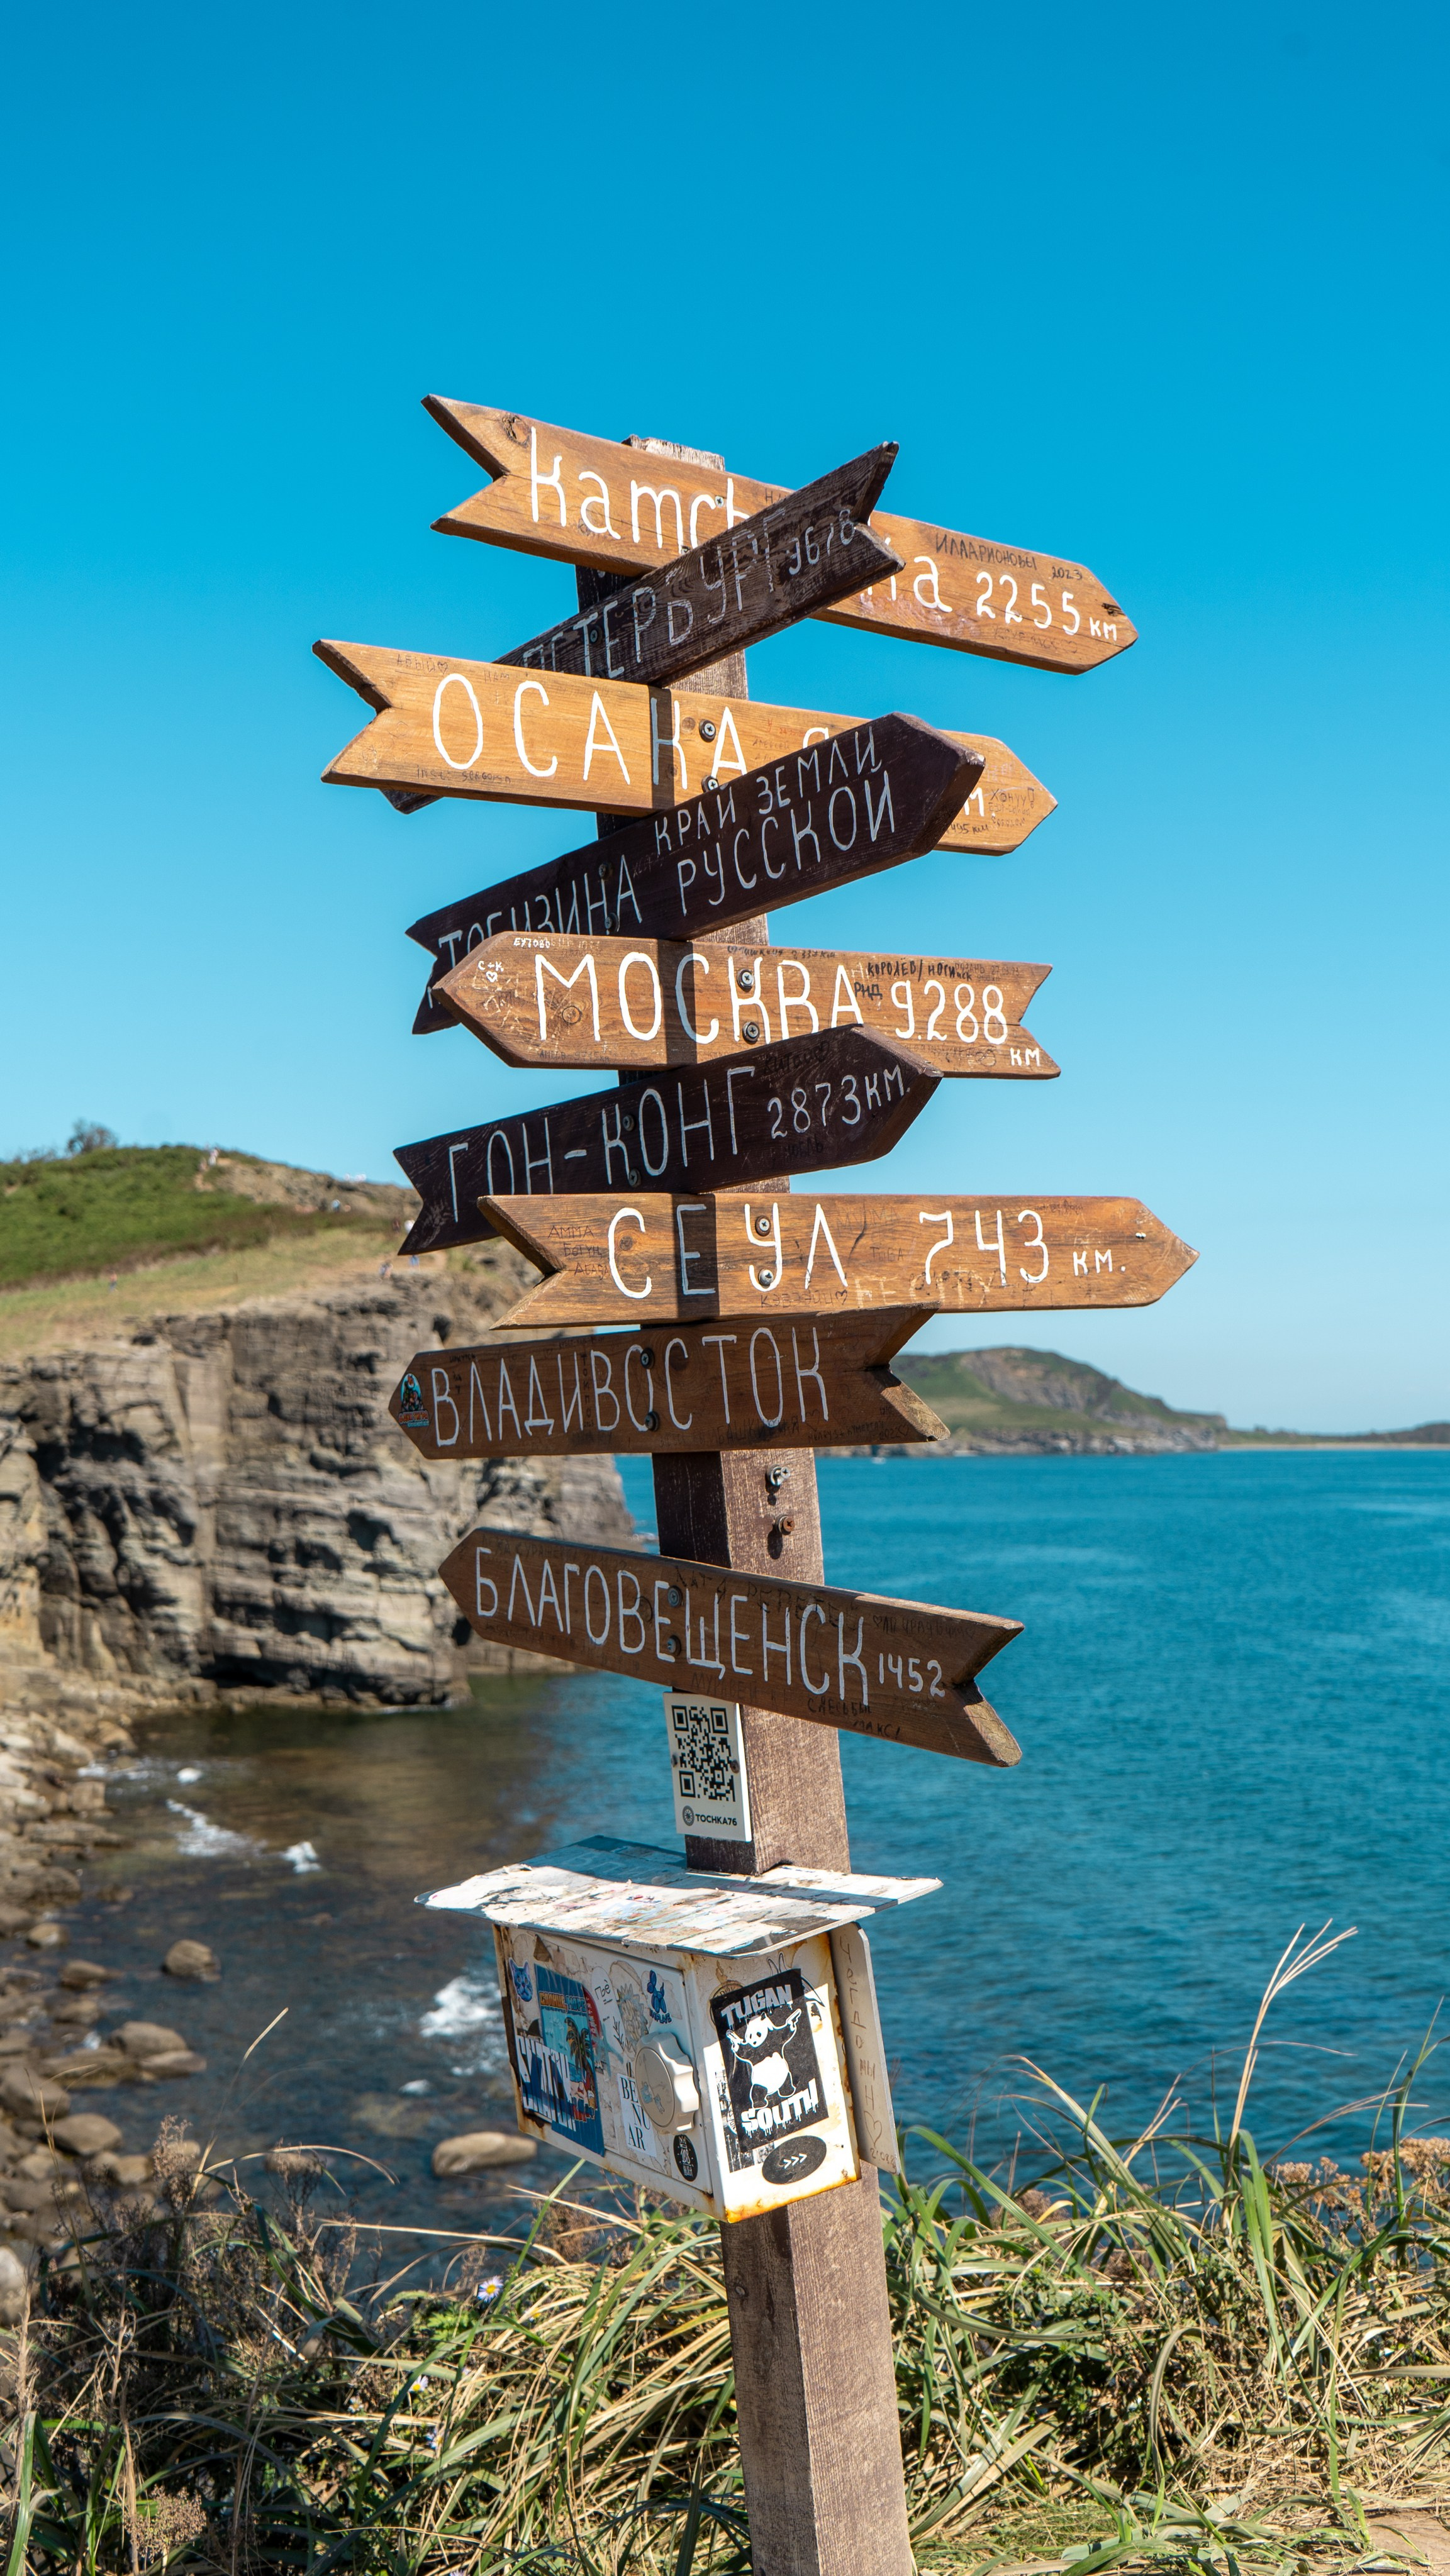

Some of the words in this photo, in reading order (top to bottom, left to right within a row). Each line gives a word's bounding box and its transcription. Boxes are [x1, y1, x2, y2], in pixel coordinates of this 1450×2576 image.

[976, 571, 1080, 635] 2255
[433, 673, 747, 790] ОСАКА
[655, 782, 736, 855] КРАЙ
[756, 726, 876, 814] ЗЕМЛИ
[678, 759, 895, 917] РУССКОЙ
[535, 952, 864, 1045] МОСКВА
[449, 1065, 756, 1223] ГОН-КОНГ
[767, 1075, 861, 1139] 2873
[547, 1224, 595, 1239] АММА
[608, 1202, 847, 1299] СЕУЛ
[919, 1209, 1049, 1286] 743
[432, 1326, 829, 1448] ВЛАДИВОСТОК
[477, 1546, 869, 1706] БЛАГОВЕЩЕНСК
[879, 1653, 945, 1698] 1452
[695, 1814, 737, 1826] TOCHKA76
[721, 1984, 793, 2028] TUGAN
[628, 2123, 646, 2151] AR
[741, 2078, 820, 2135] SOUTH
